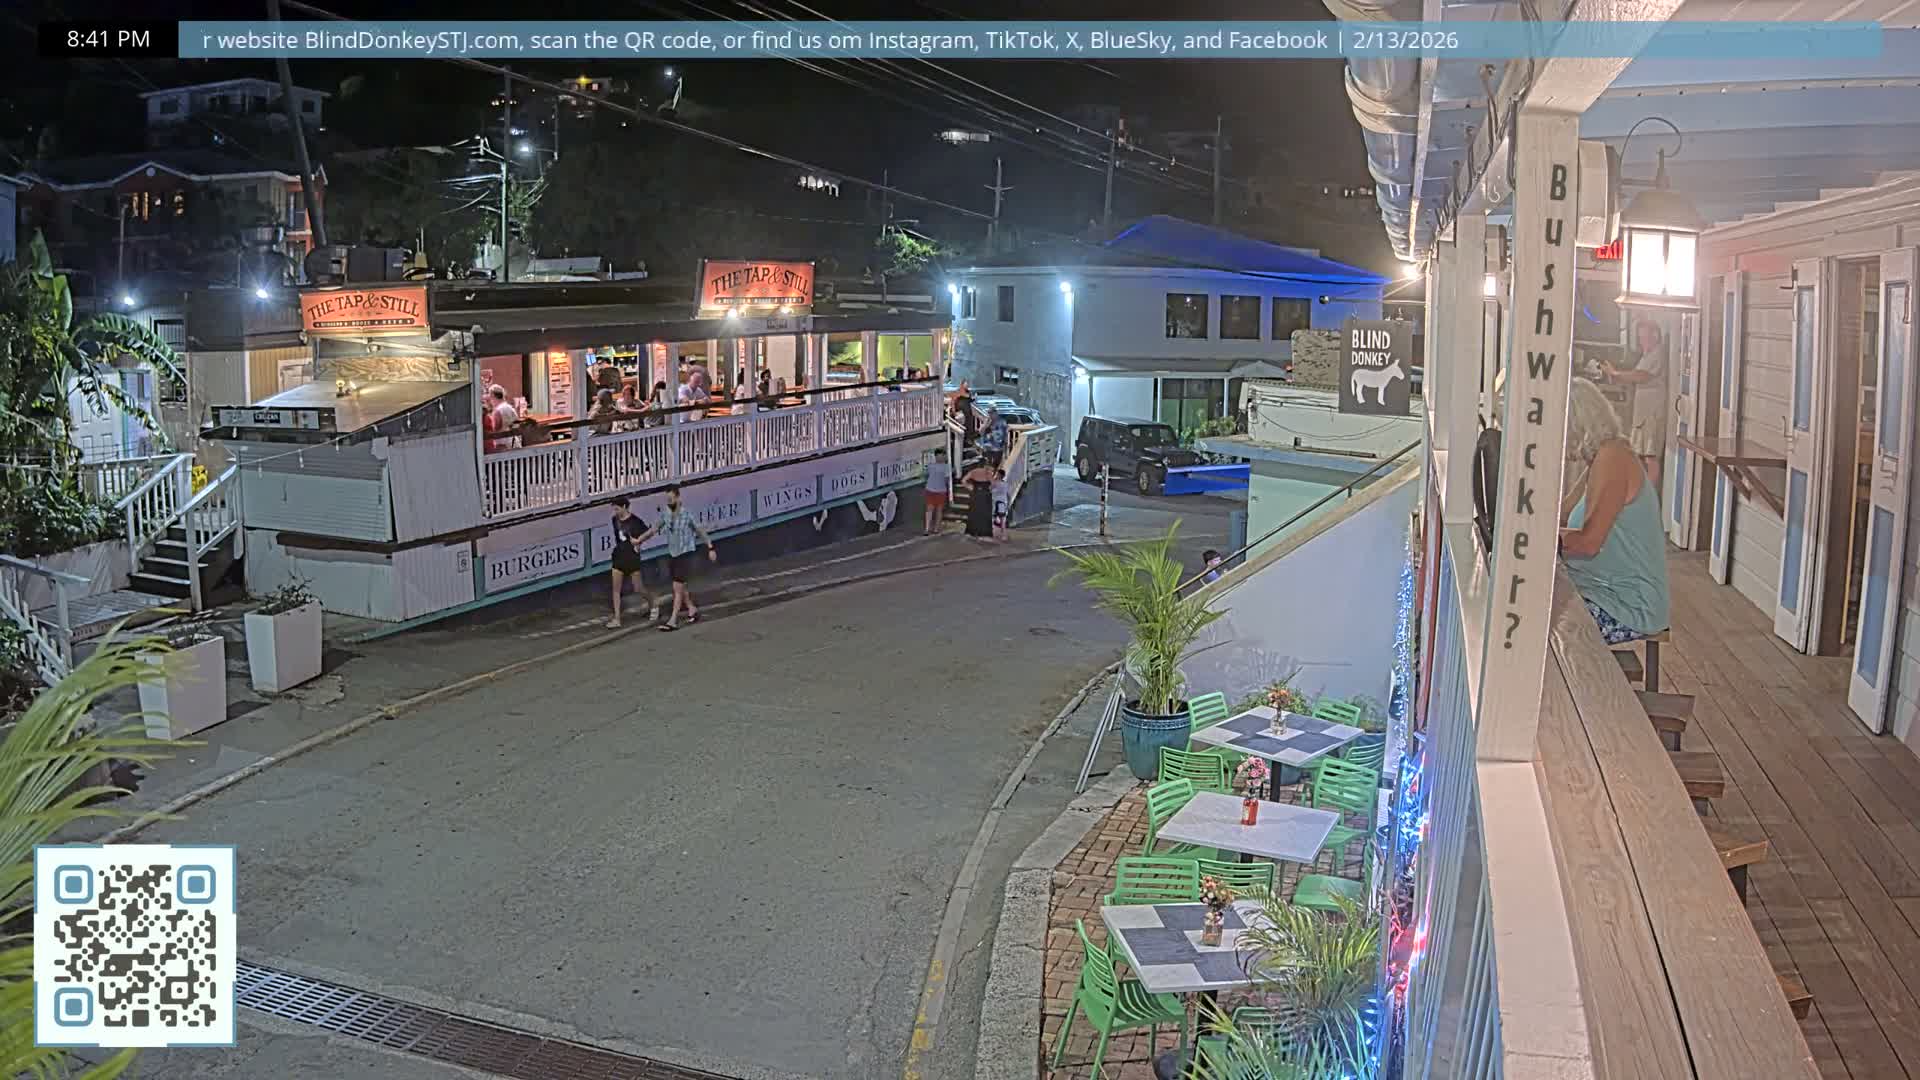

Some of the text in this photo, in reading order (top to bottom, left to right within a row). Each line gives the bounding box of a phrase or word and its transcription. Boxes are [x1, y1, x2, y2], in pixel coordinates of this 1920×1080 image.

[712, 270, 742, 296] THE
[743, 266, 770, 285] TAP
[782, 269, 809, 296] STILL
[307, 299, 336, 320] THE
[335, 294, 364, 313] TAP
[380, 294, 420, 318] STILL
[1351, 329, 1391, 350] BLIND
[1351, 350, 1392, 367] DONKEY
[1502, 163, 1568, 651] Bushwacker?
[831, 471, 866, 492] DOGS
[763, 486, 813, 508] WINGS
[491, 543, 580, 580] BURGERS
